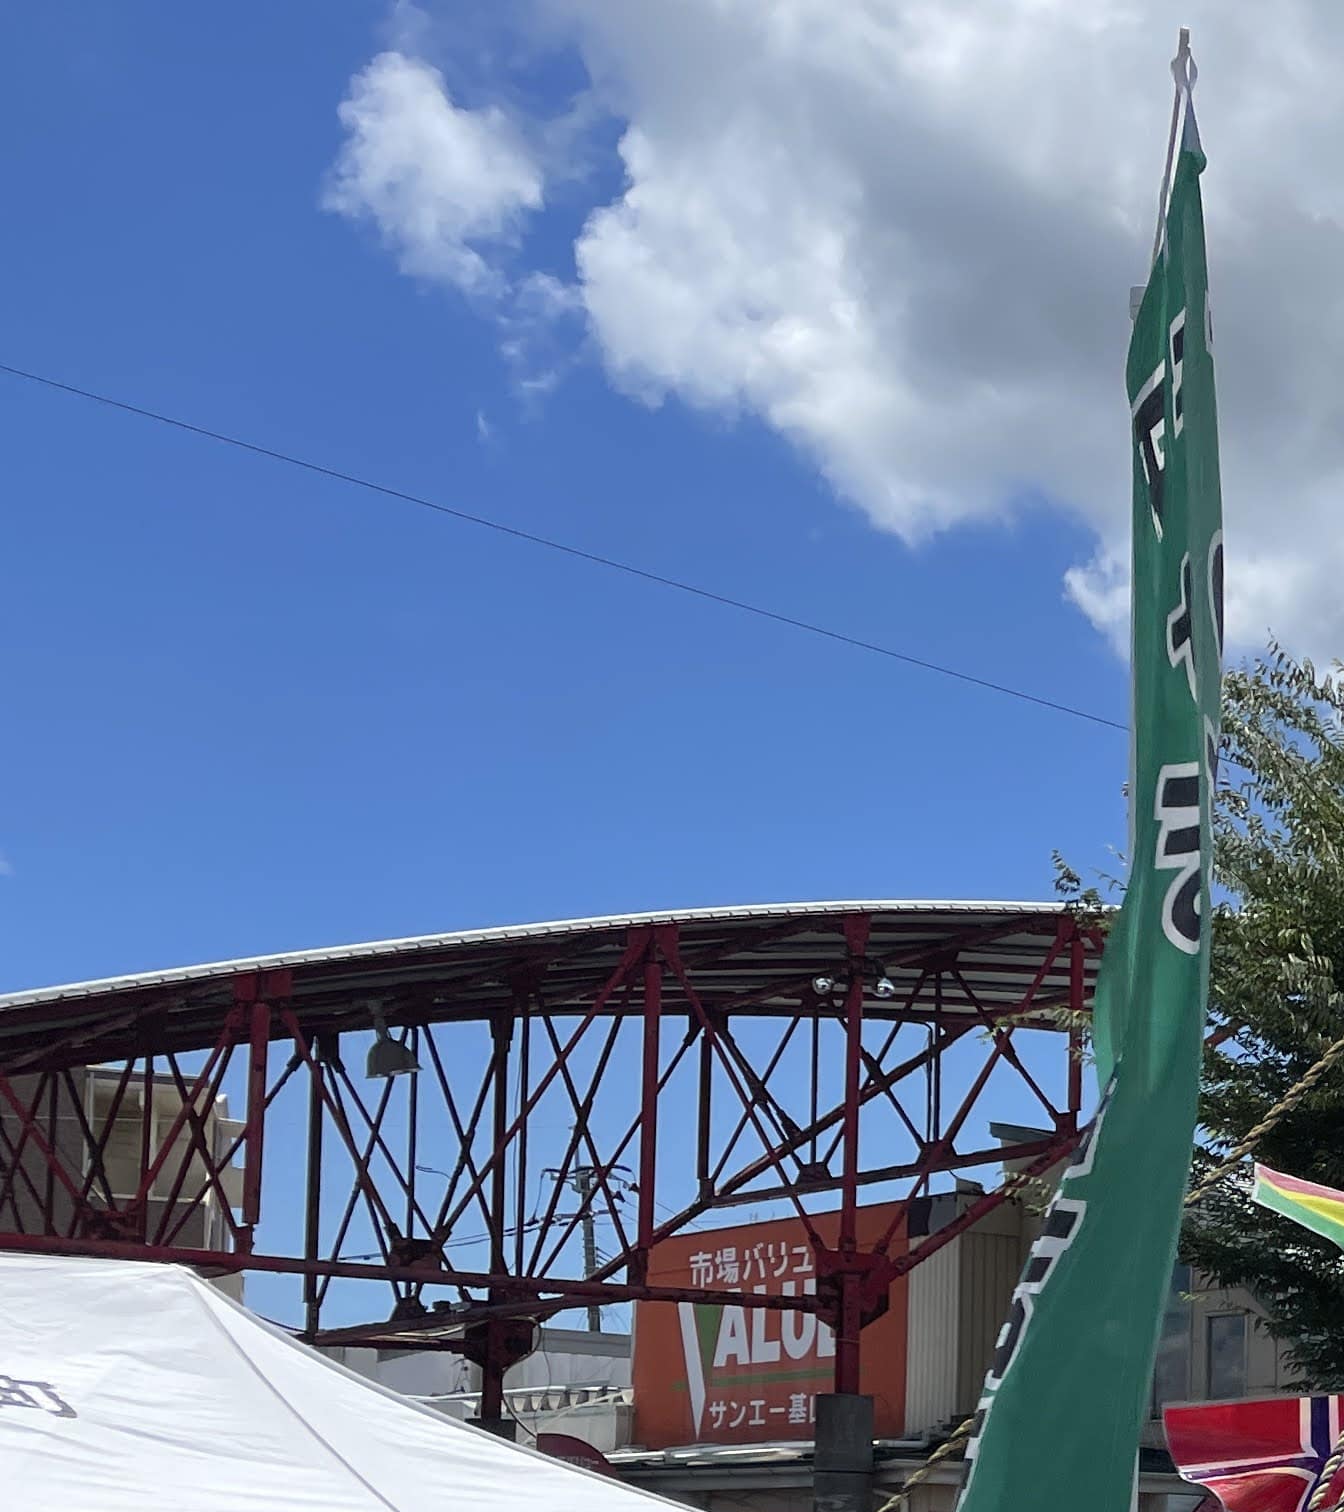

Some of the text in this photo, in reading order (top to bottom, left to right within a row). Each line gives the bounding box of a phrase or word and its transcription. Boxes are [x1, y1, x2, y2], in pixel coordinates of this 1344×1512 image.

[689, 1240, 838, 1288] 市場バリュ
